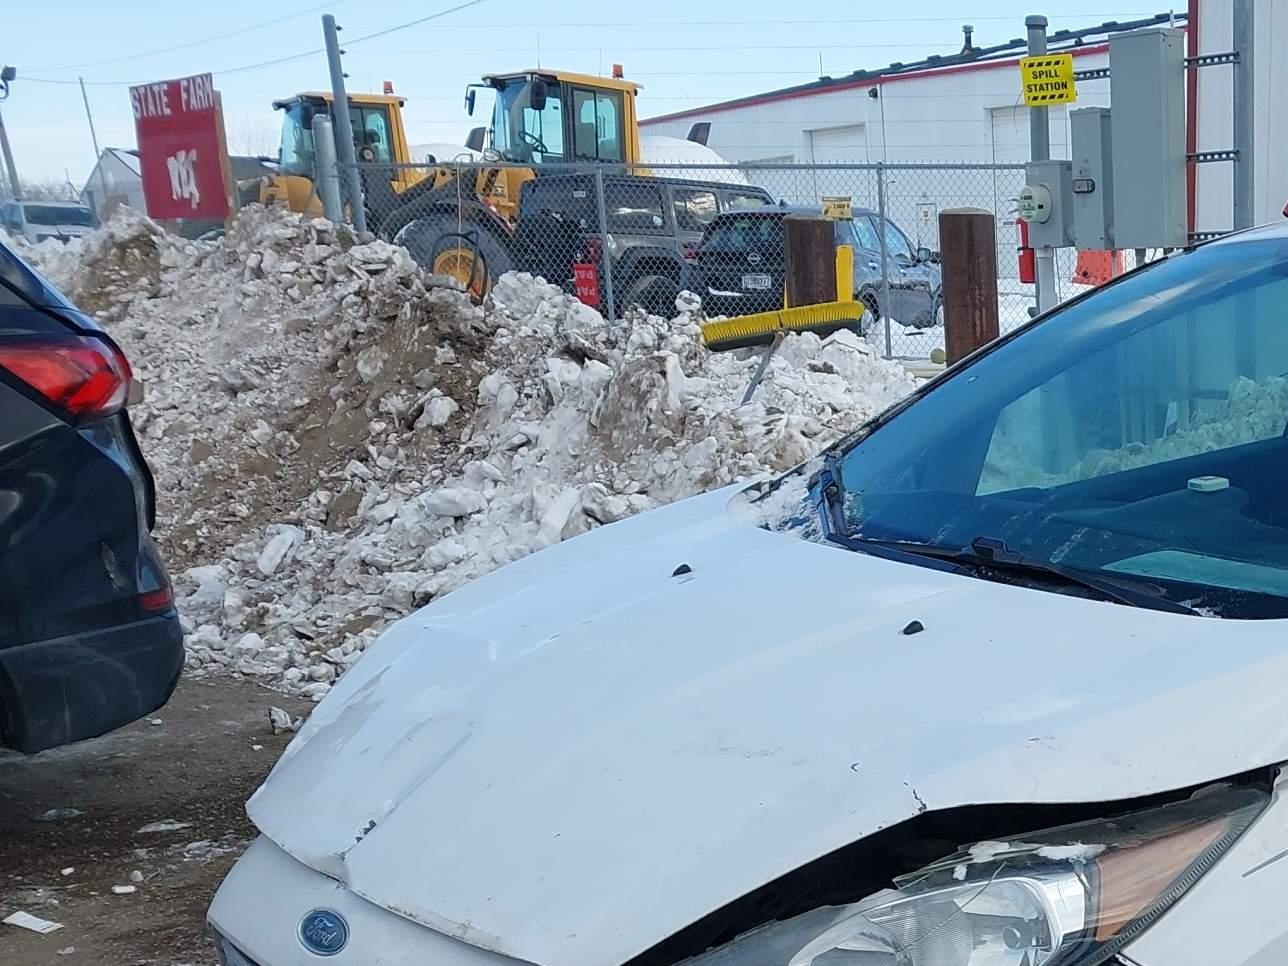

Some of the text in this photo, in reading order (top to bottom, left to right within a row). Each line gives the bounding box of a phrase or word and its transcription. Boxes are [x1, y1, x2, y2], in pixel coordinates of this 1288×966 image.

[1031, 69, 1060, 79] SPILL
[1026, 81, 1068, 93] STATION
[131, 74, 214, 119] STATE FARM
